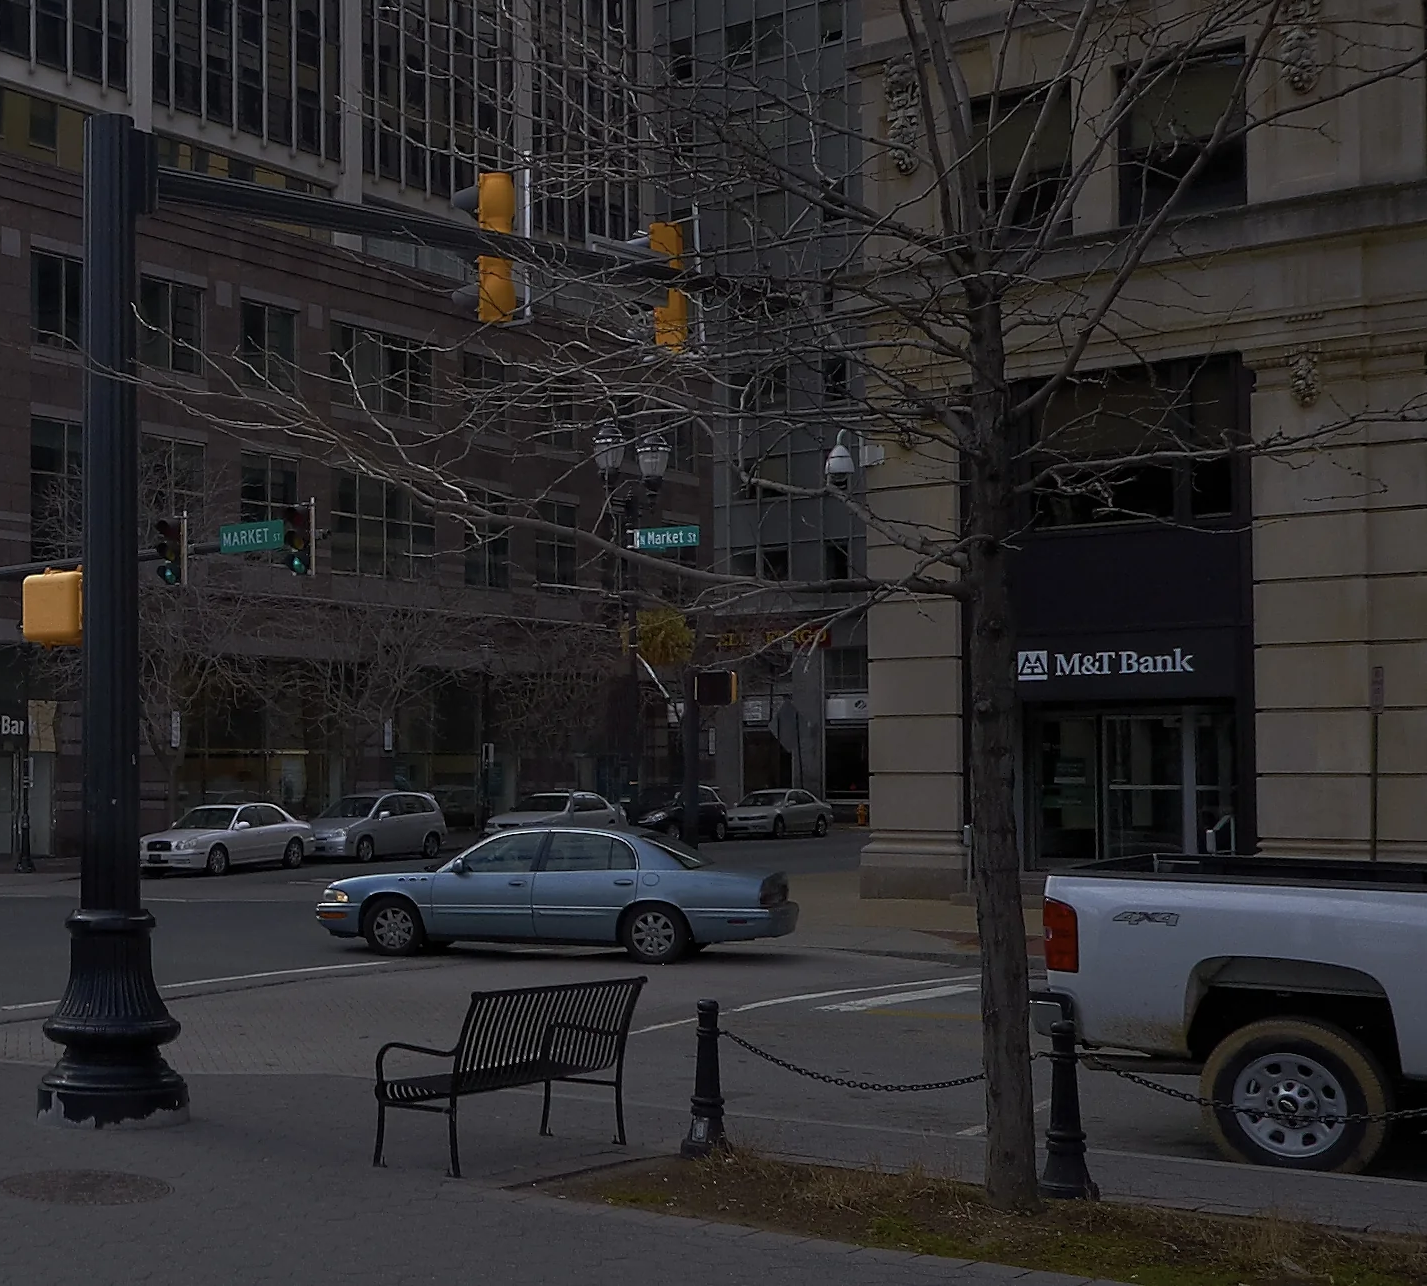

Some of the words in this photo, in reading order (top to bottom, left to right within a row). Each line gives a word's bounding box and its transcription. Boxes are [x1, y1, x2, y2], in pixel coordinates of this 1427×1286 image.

[222, 527, 269, 547] MARKET
[272, 533, 281, 542] ST
[647, 530, 684, 545] Market
[687, 532, 696, 543] St
[1053, 650, 1116, 676] M&T
[1118, 647, 1195, 674] Bank
